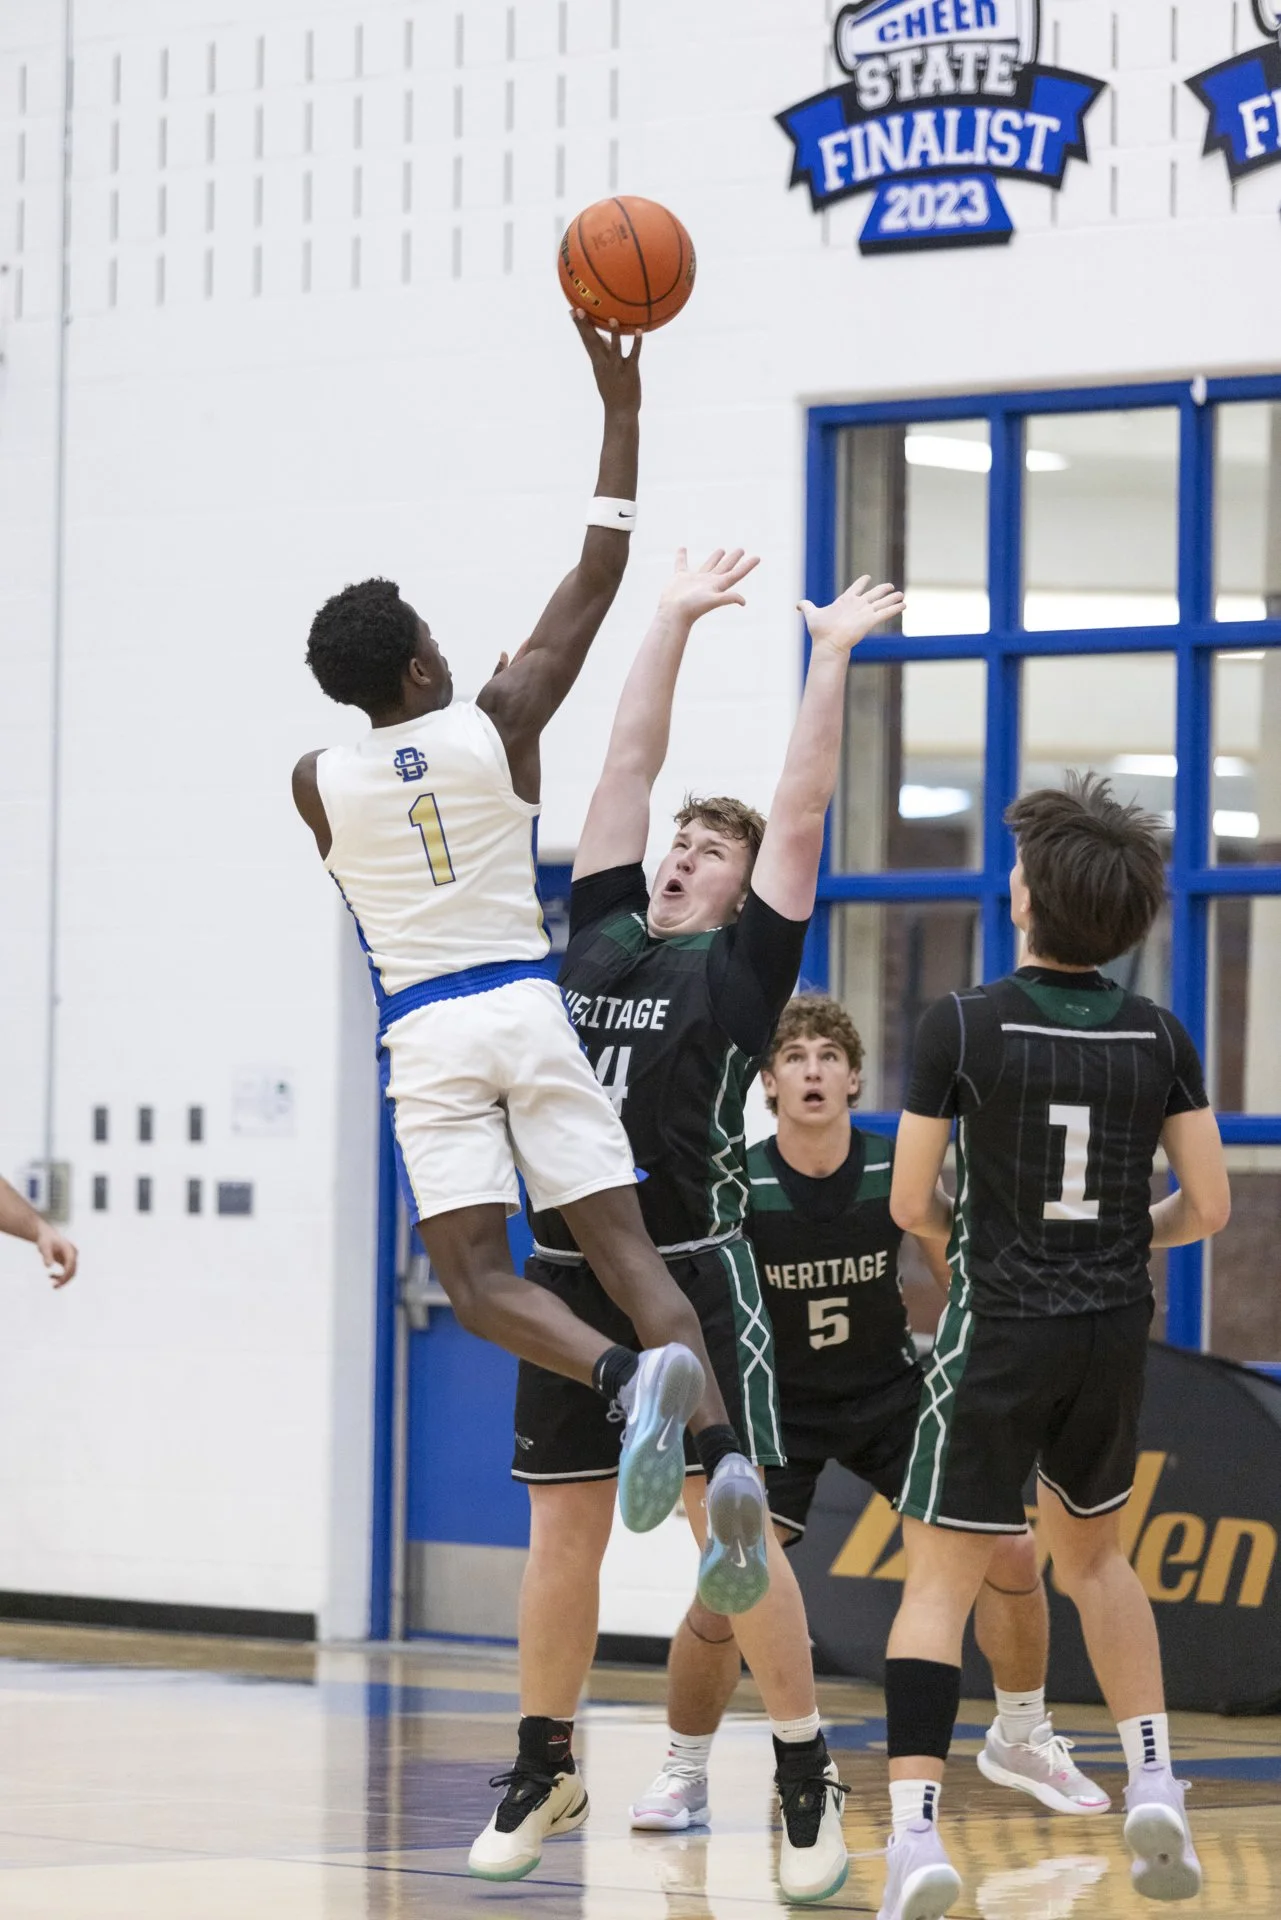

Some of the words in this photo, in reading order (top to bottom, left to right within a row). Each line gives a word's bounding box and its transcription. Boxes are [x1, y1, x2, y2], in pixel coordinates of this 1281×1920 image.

[855, 43, 1019, 109] STATE
[817, 108, 1062, 192] FINALIST
[879, 179, 991, 232] 2023
[408, 792, 456, 887] 1
[586, 1045, 632, 1117] 4
[1043, 1104, 1100, 1220] 1
[764, 1250, 888, 1290] HERITAGE
[808, 1297, 849, 1350] 5
